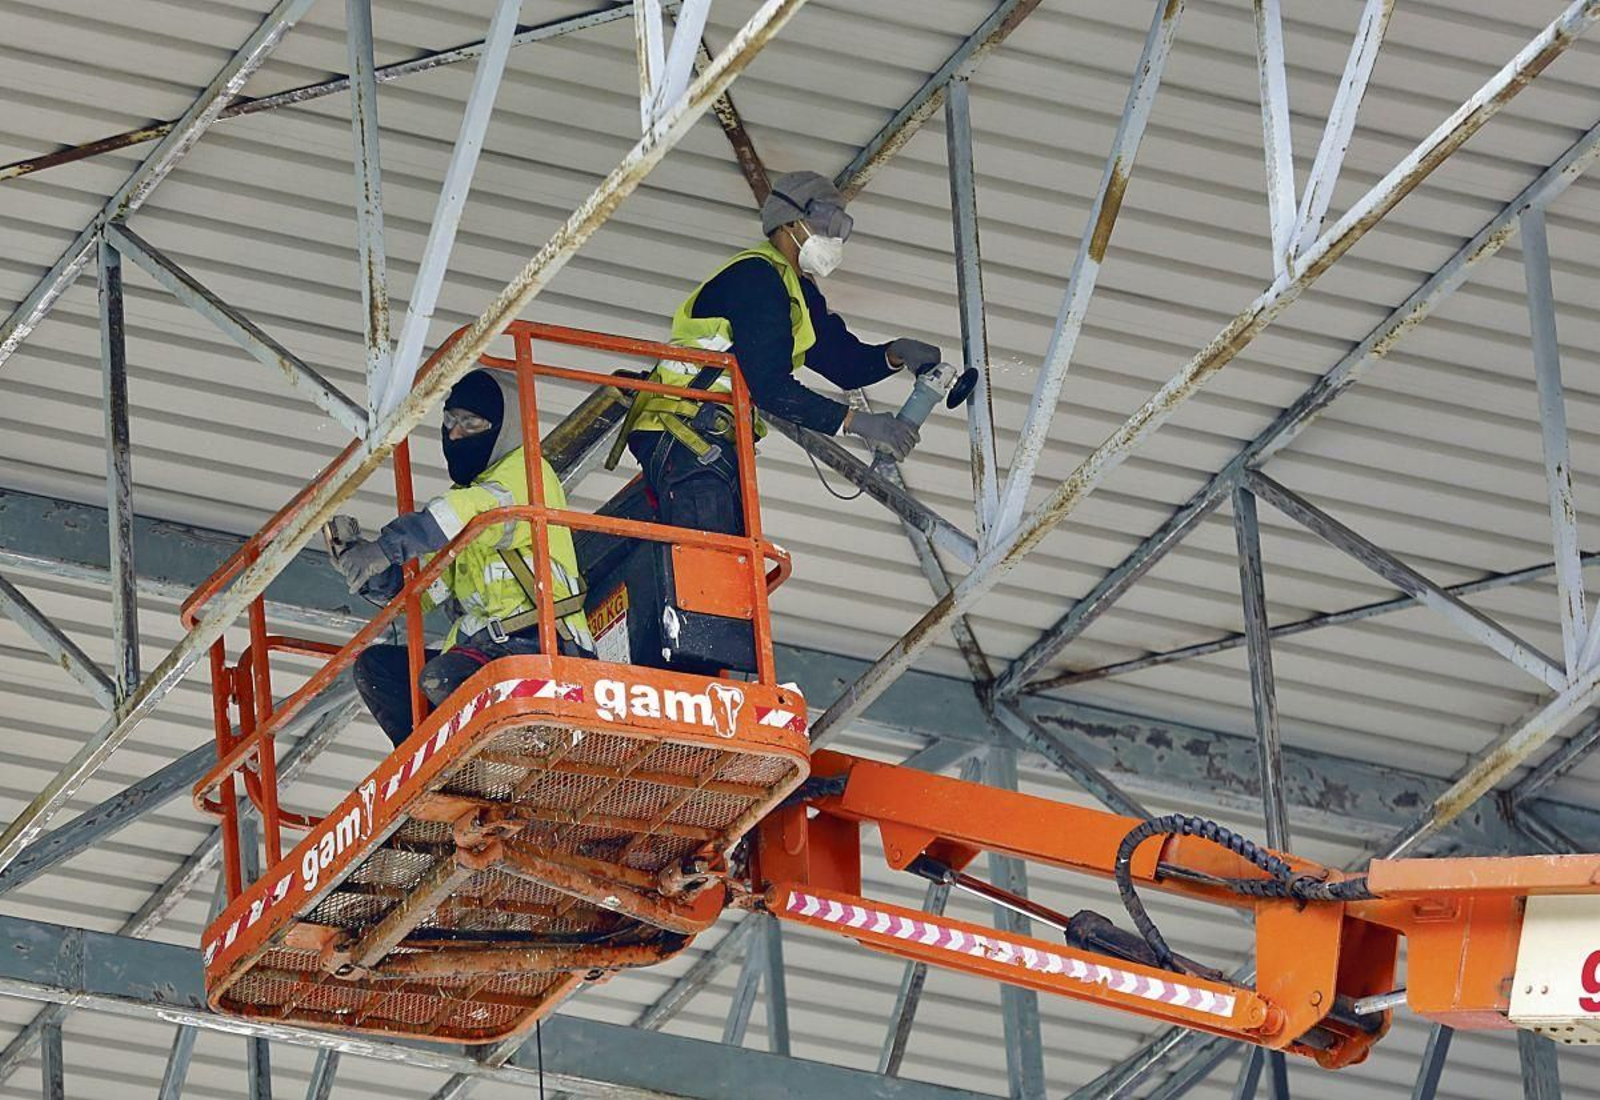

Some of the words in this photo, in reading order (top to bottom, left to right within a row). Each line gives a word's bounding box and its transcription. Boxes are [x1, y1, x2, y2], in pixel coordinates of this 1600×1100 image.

[606, 594, 623, 625] KG
[594, 679, 714, 726] gam
[302, 807, 360, 892] gam
